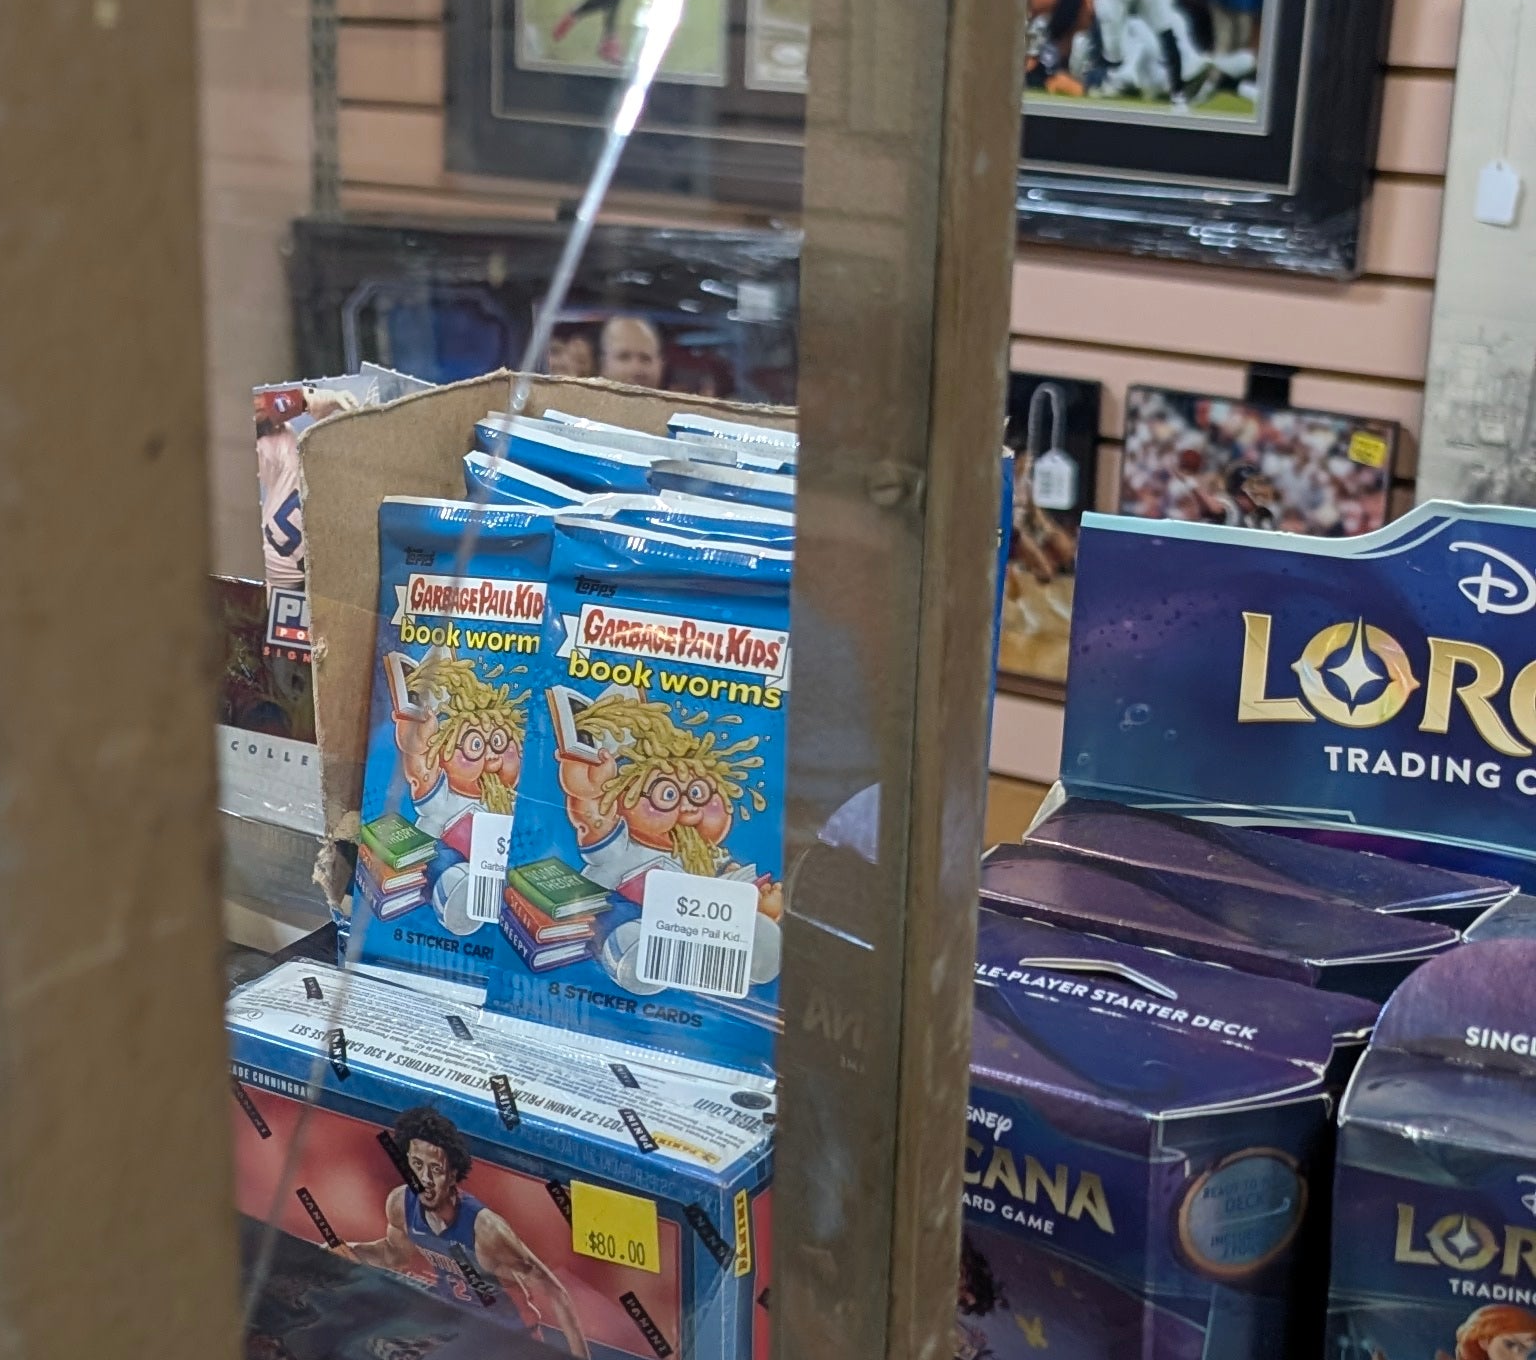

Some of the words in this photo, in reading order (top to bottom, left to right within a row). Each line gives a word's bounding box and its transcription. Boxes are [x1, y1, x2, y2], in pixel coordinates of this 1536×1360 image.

[400, 616, 461, 648] book
[569, 651, 653, 688] book
[660, 670, 782, 709] worms
[1324, 745, 1501, 789] TRADING
[676, 896, 732, 922] $2.00
[394, 928, 403, 941] 8
[407, 932, 460, 954] STICKER
[498, 914, 528, 958] CREEPY
[656, 920, 699, 937] Garbage
[701, 926, 721, 939] Pail
[548, 982, 560, 995] 8
[564, 984, 638, 1014] STICKER
[643, 1003, 703, 1027] CARDS
[974, 962, 1088, 998] LE-PLAYER
[1090, 989, 1189, 1023] STARTER
[1191, 1014, 1258, 1040] DECK
[288, 1023, 310, 1037] SET
[345, 1038, 386, 1059] 330-CAR
[386, 1052, 398, 1062] A
[397, 1054, 445, 1077] FEATURES
[545, 1099, 579, 1118] PANINI
[580, 1111, 625, 1132] 2021-22
[624, 1110, 653, 1151] PANINI
[1002, 1204, 1054, 1235] GAME
[588, 1231, 646, 1266] $80.00
[628, 1296, 669, 1355] PANINI
